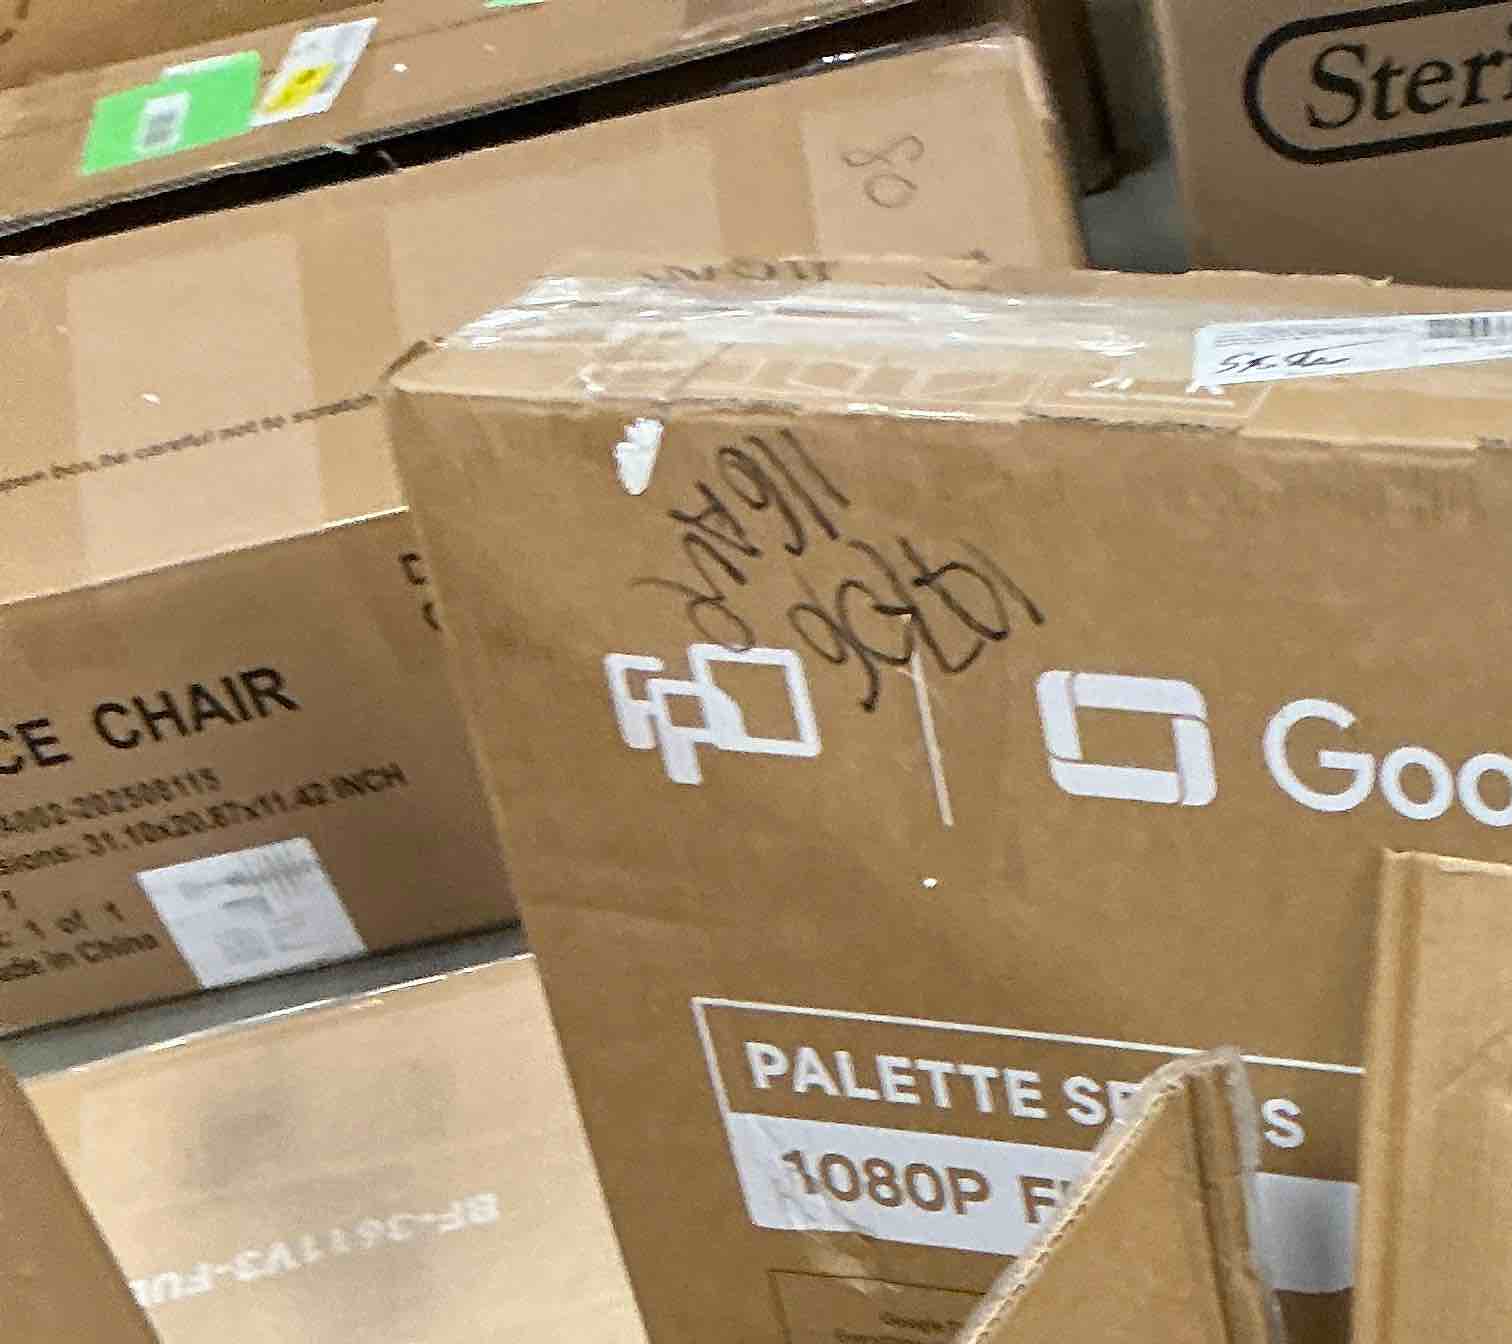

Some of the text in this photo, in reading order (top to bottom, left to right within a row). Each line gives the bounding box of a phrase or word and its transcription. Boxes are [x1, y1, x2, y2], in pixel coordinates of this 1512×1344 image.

[92, 665, 301, 751] CHAIR
[743, 1040, 1050, 1121] PALETTE
[782, 1149, 992, 1216] 1080P
